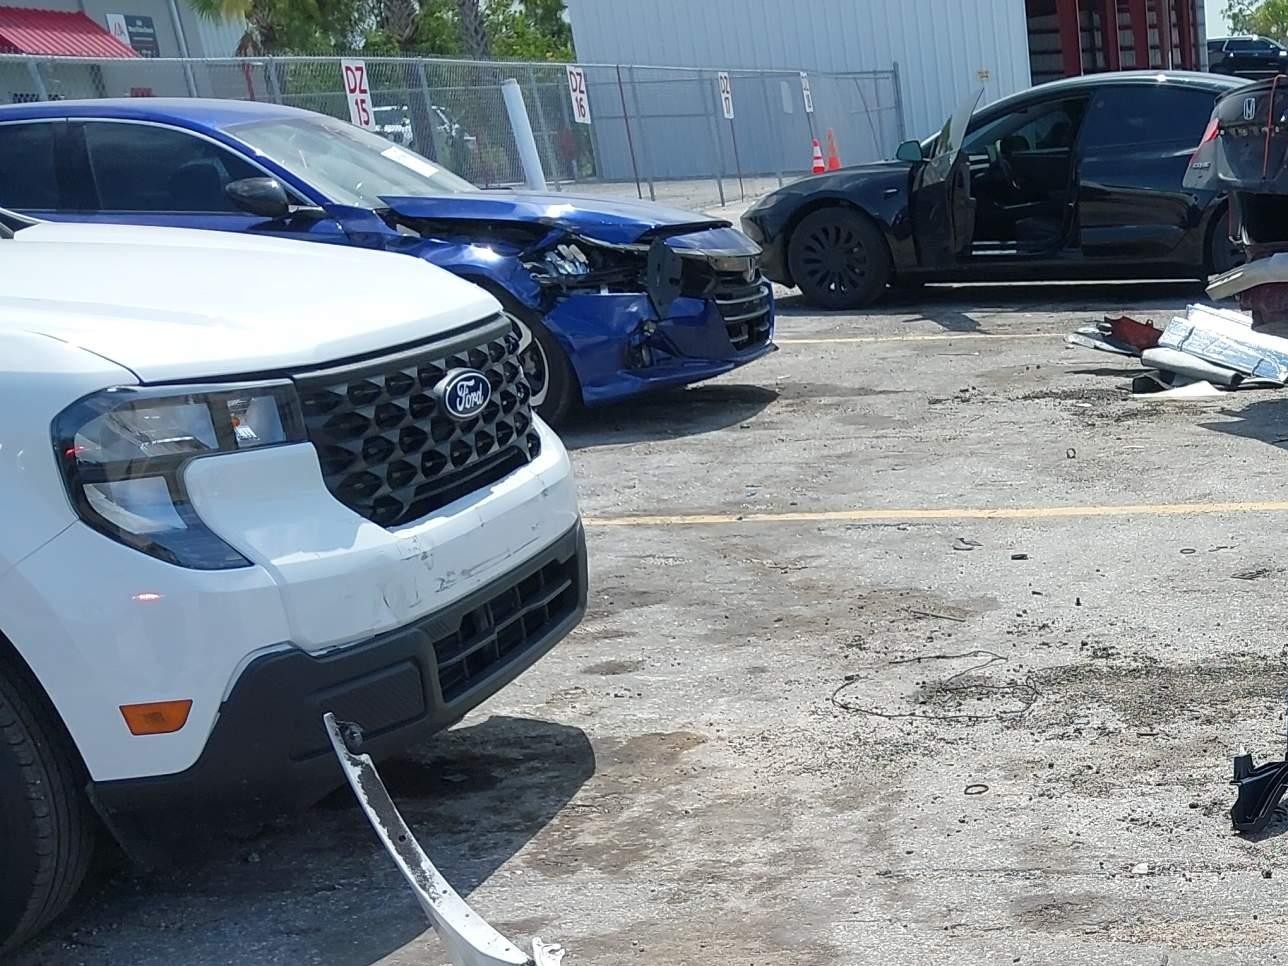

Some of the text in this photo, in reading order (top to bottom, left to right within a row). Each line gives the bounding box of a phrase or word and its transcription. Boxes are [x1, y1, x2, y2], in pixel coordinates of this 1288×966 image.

[345, 66, 368, 94] DZ
[569, 71, 585, 94] DZ
[355, 98, 370, 126] 15
[575, 96, 586, 118] 16
[456, 379, 484, 412] Ford
